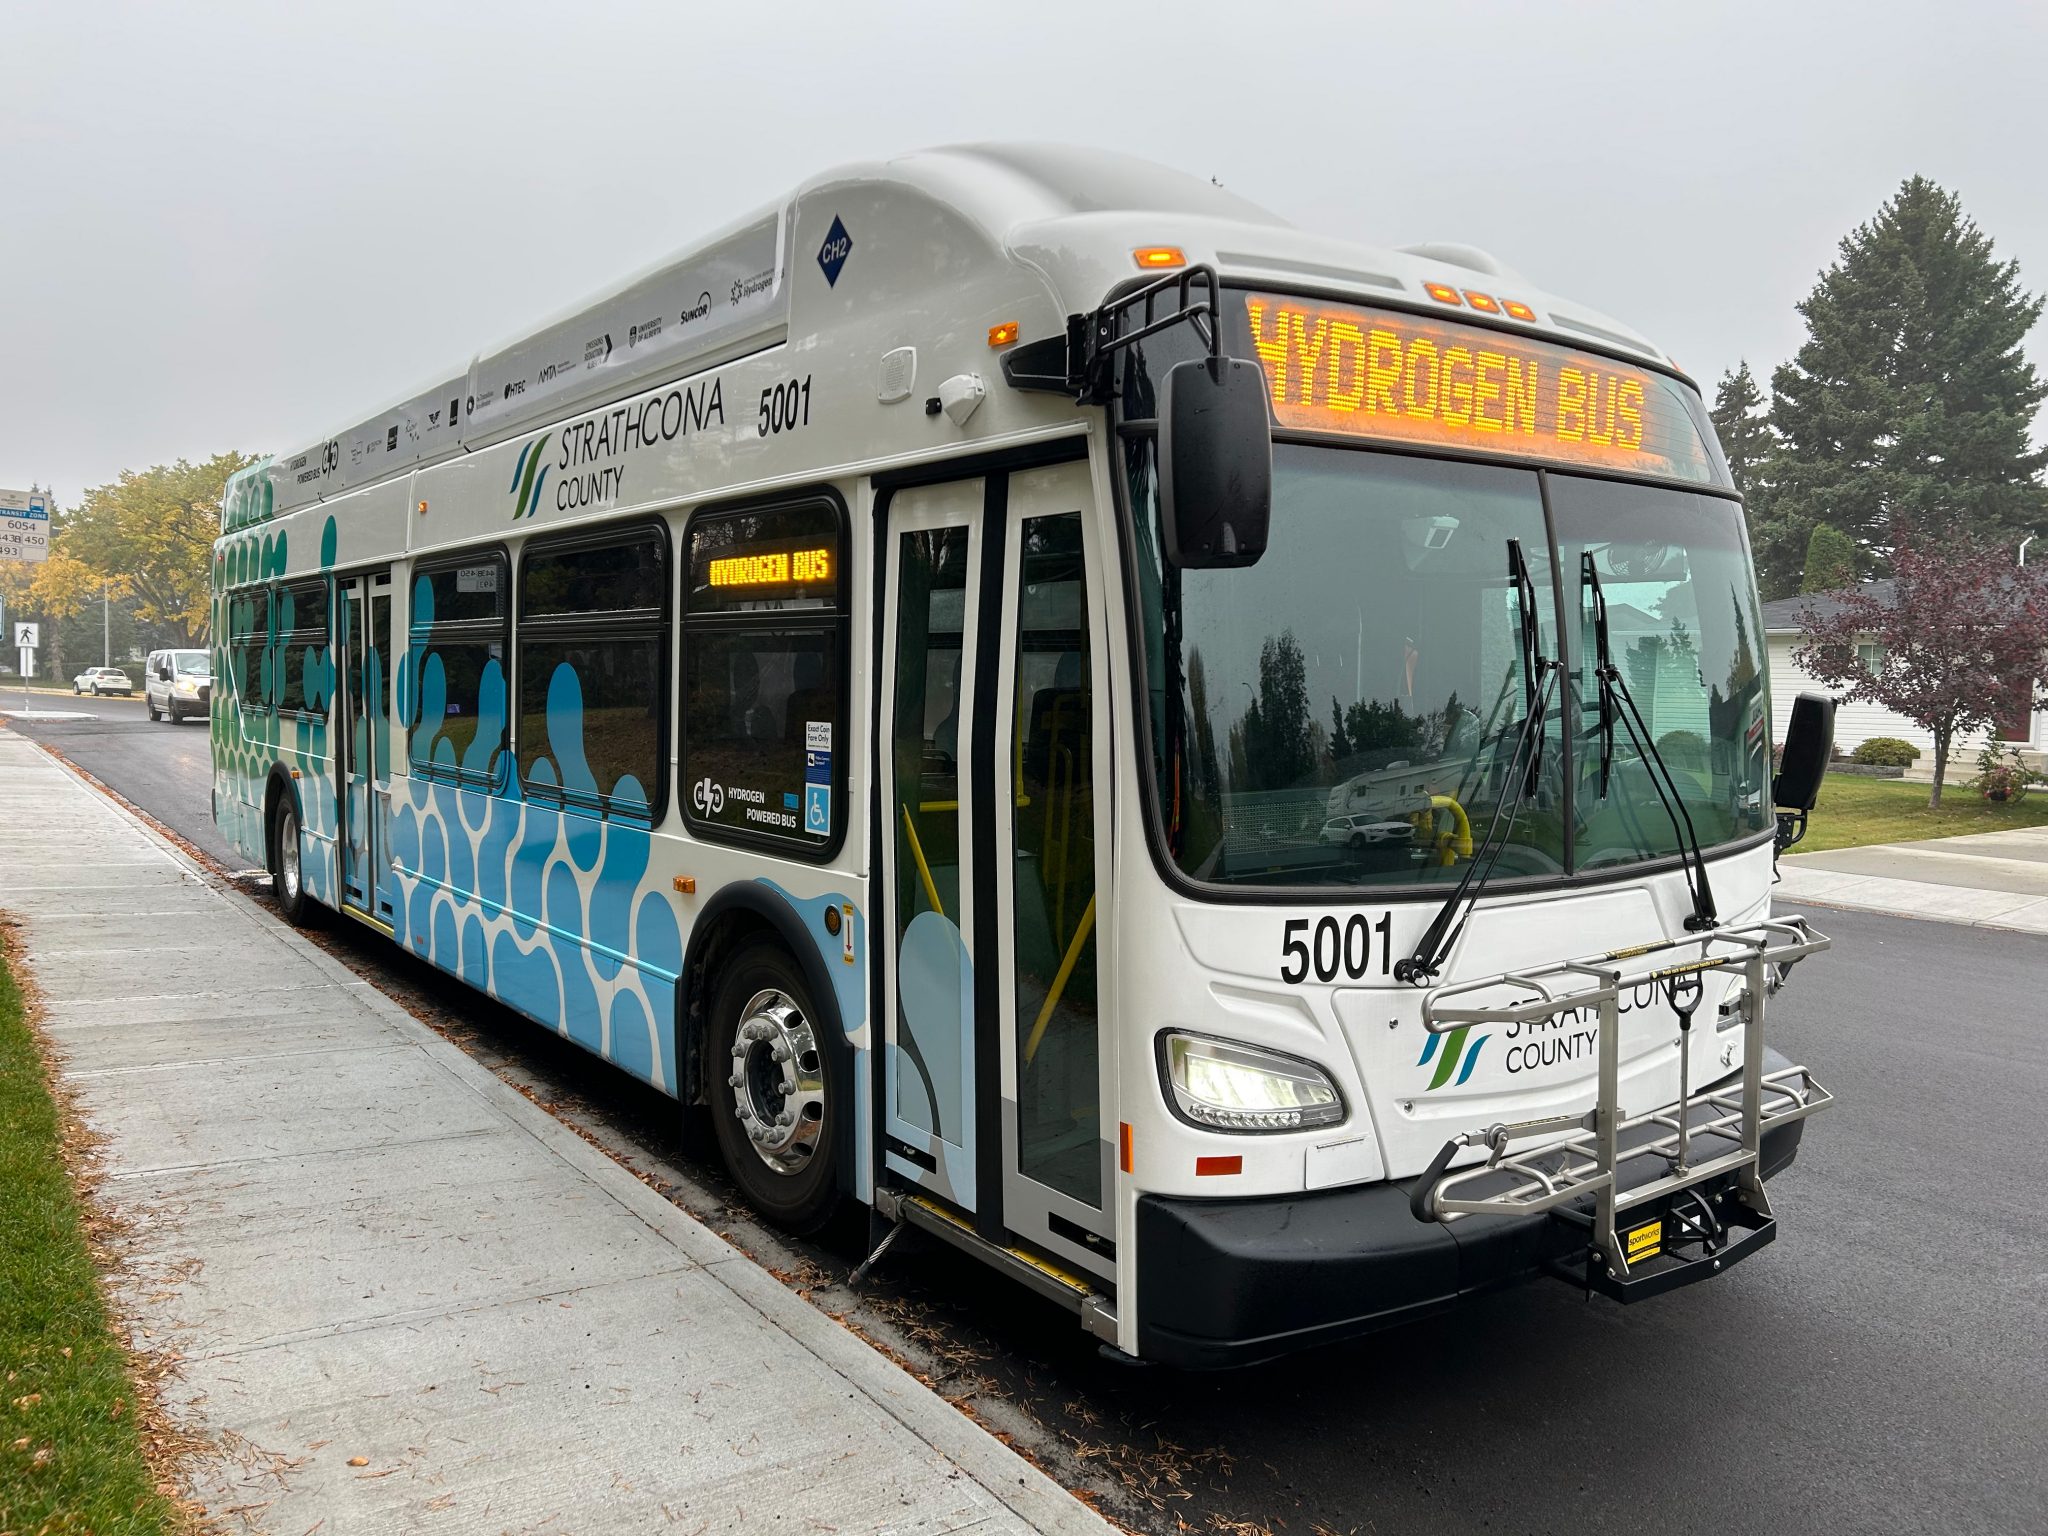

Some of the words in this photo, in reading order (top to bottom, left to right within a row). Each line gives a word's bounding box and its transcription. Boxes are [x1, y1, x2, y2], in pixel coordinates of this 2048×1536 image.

[822, 237, 847, 264] CH2
[637, 316, 662, 333] UNIVERSITY
[1249, 305, 1538, 437] HYDROGEN
[1556, 367, 1645, 452] BUS
[758, 374, 812, 438] 5001
[558, 377, 725, 470] STRATHCONA
[556, 465, 625, 511] COUNTY
[7, 520, 36, 531] 6054
[0, 534, 21, 543] 43B
[24, 536, 45, 545] 450
[710, 553, 788, 586] HYDROGEN
[793, 549, 828, 580] BUS
[818, 734, 829, 744] Only
[728, 786, 765, 804] HYDROGEN
[746, 807, 781, 825] POWERED
[781, 814, 797, 829] BUS
[1281, 911, 1391, 985] 5001
[1506, 1029, 1598, 1073] COUNTY
[1629, 1228, 1660, 1246] sportworks
